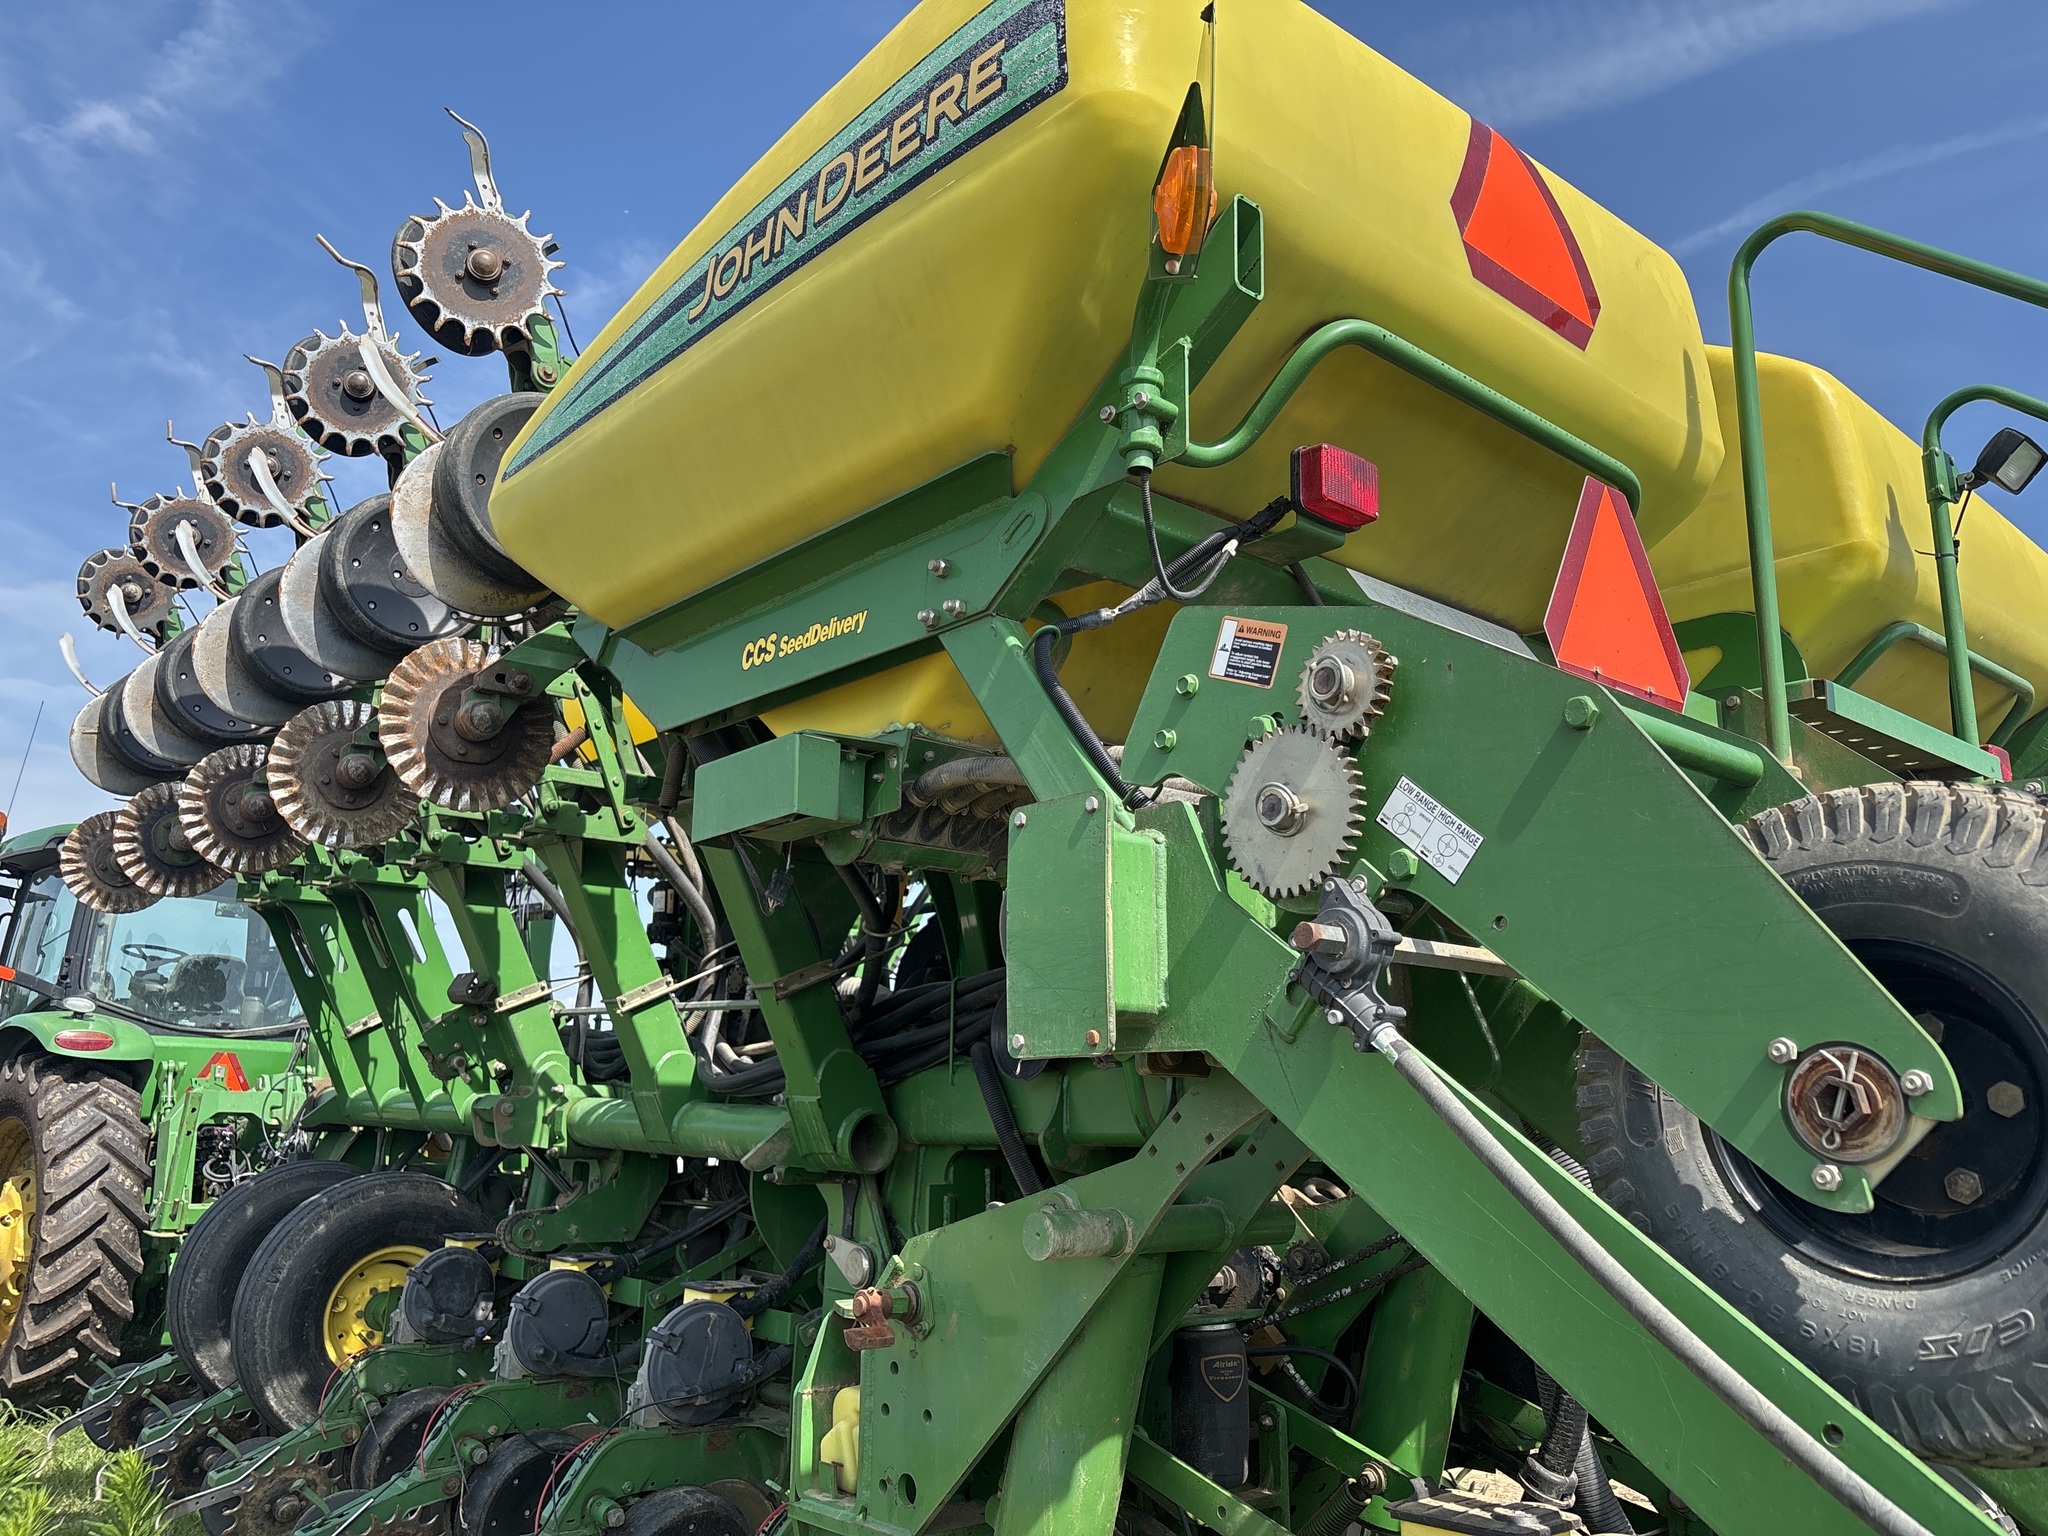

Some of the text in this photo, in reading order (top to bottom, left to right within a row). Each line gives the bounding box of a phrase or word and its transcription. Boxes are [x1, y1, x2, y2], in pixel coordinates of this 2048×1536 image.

[687, 38, 1006, 322] JOHN DEERE
[741, 609, 869, 671] CCS SeedDelivery
[1246, 626, 1282, 639] WARNING
[1398, 780, 1438, 814] LOW RANGE
[1438, 811, 1480, 847] HIGH RANGE
[1838, 1308, 1868, 1323] NOT
